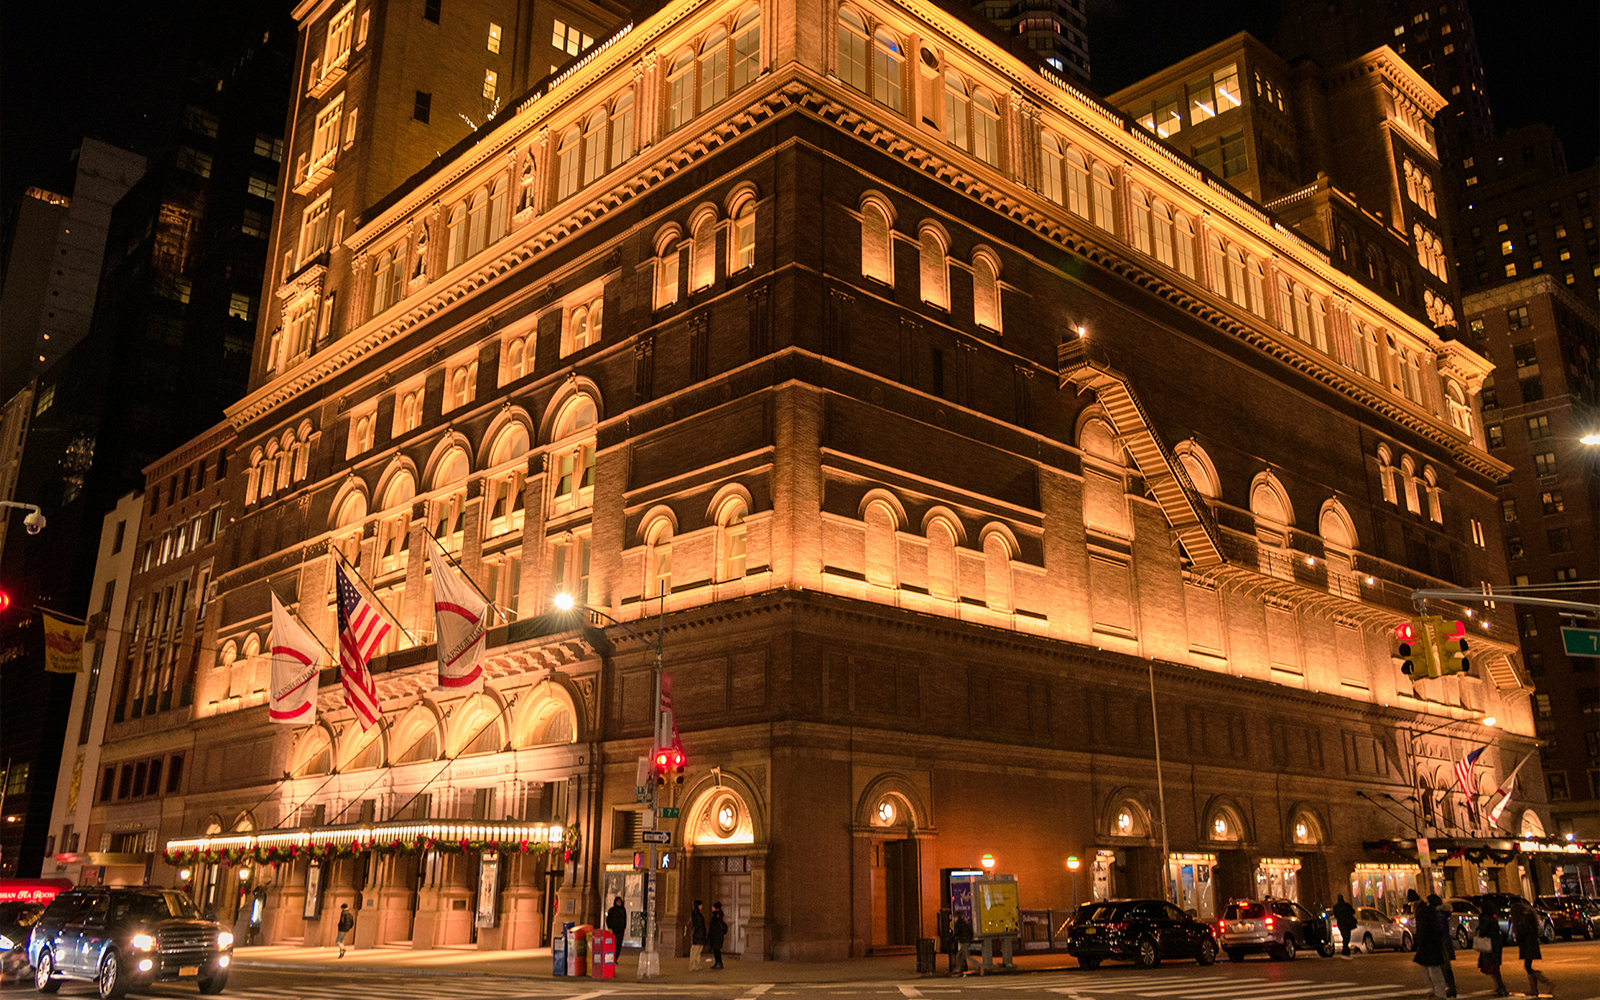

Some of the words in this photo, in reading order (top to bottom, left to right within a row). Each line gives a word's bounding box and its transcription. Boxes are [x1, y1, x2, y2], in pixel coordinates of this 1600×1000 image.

[441, 637, 472, 663] CARNEGIE
[1588, 635, 1598, 651] 7
[272, 677, 302, 700] CARNEGIE
